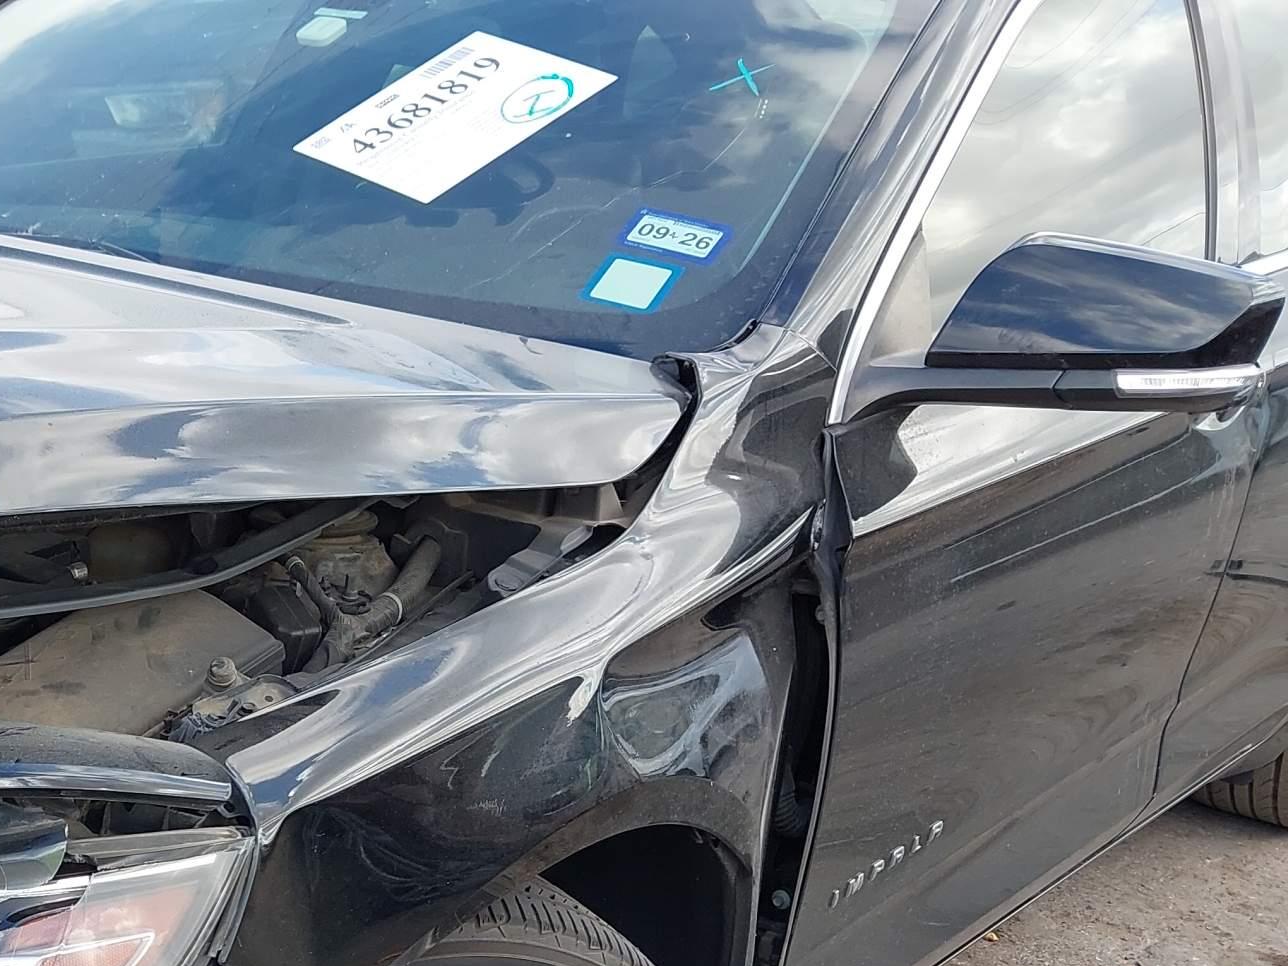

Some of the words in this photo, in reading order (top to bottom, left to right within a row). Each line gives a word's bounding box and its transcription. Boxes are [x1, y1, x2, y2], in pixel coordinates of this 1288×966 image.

[352, 57, 501, 155] 43681819
[637, 222, 670, 240] 09
[677, 231, 714, 250] 26
[828, 820, 944, 909] IMPALA
